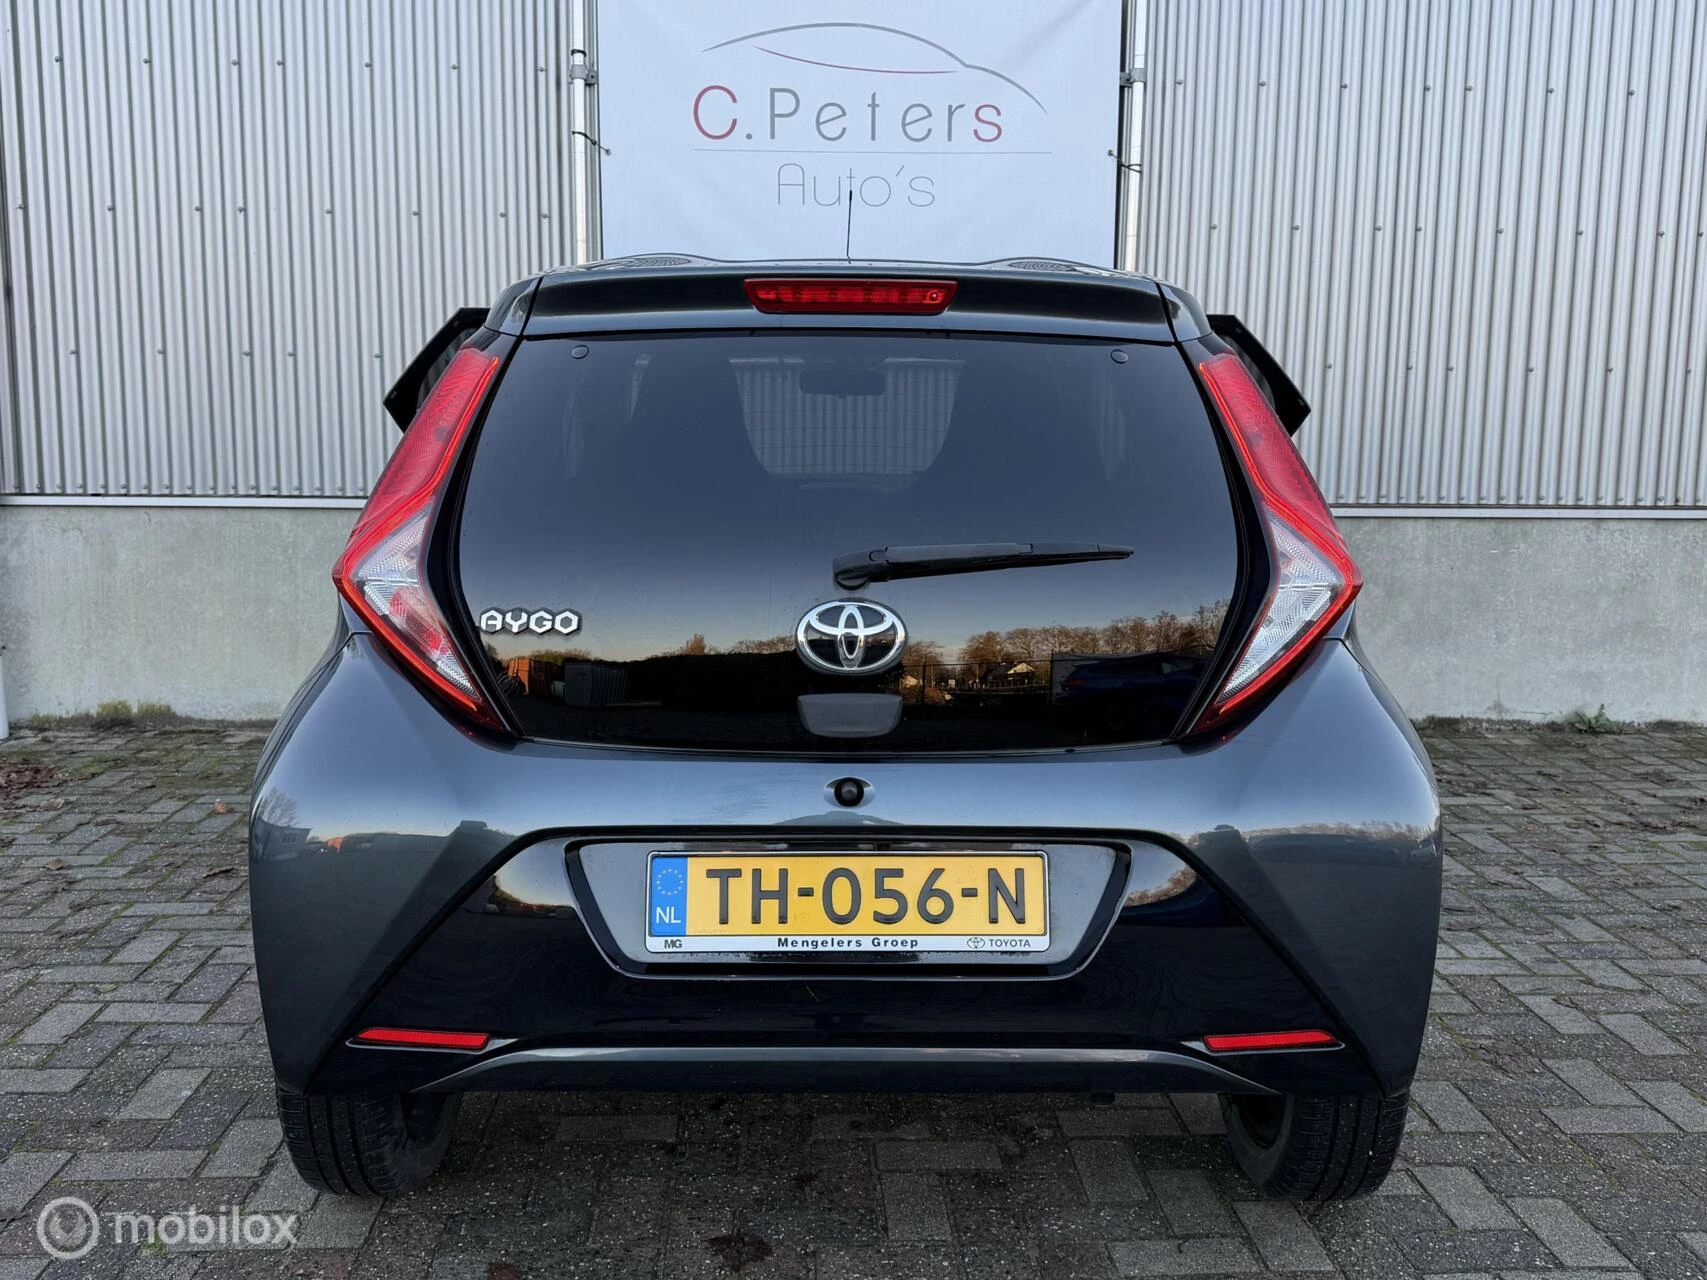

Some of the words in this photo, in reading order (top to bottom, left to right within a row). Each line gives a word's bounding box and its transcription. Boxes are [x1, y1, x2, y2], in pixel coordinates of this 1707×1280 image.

[480, 609, 581, 635] AYGO
[705, 866, 1027, 926] TH-056-N
[655, 907, 682, 925] NL
[664, 939, 683, 949] MG
[777, 937, 862, 950] Mengelers
[871, 937, 919, 950] Groep
[988, 938, 1031, 948] TOYOTA
